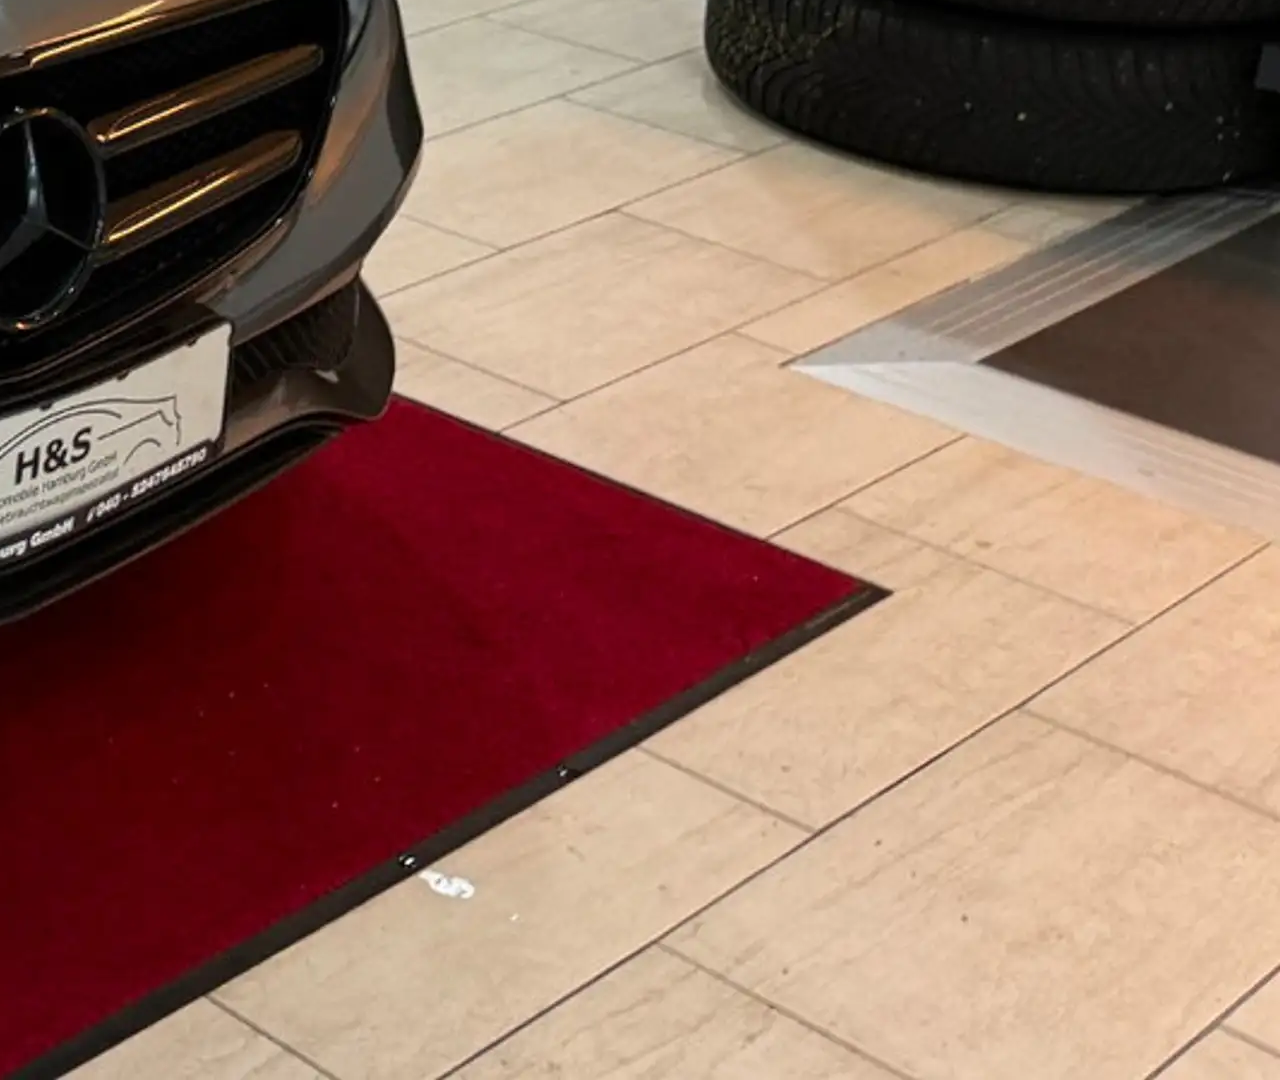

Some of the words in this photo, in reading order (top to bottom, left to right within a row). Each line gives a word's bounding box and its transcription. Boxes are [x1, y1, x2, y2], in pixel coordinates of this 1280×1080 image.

[15, 426, 92, 485] H&S
[41, 464, 86, 493] Hamburg
[29, 516, 76, 549] GmbH
